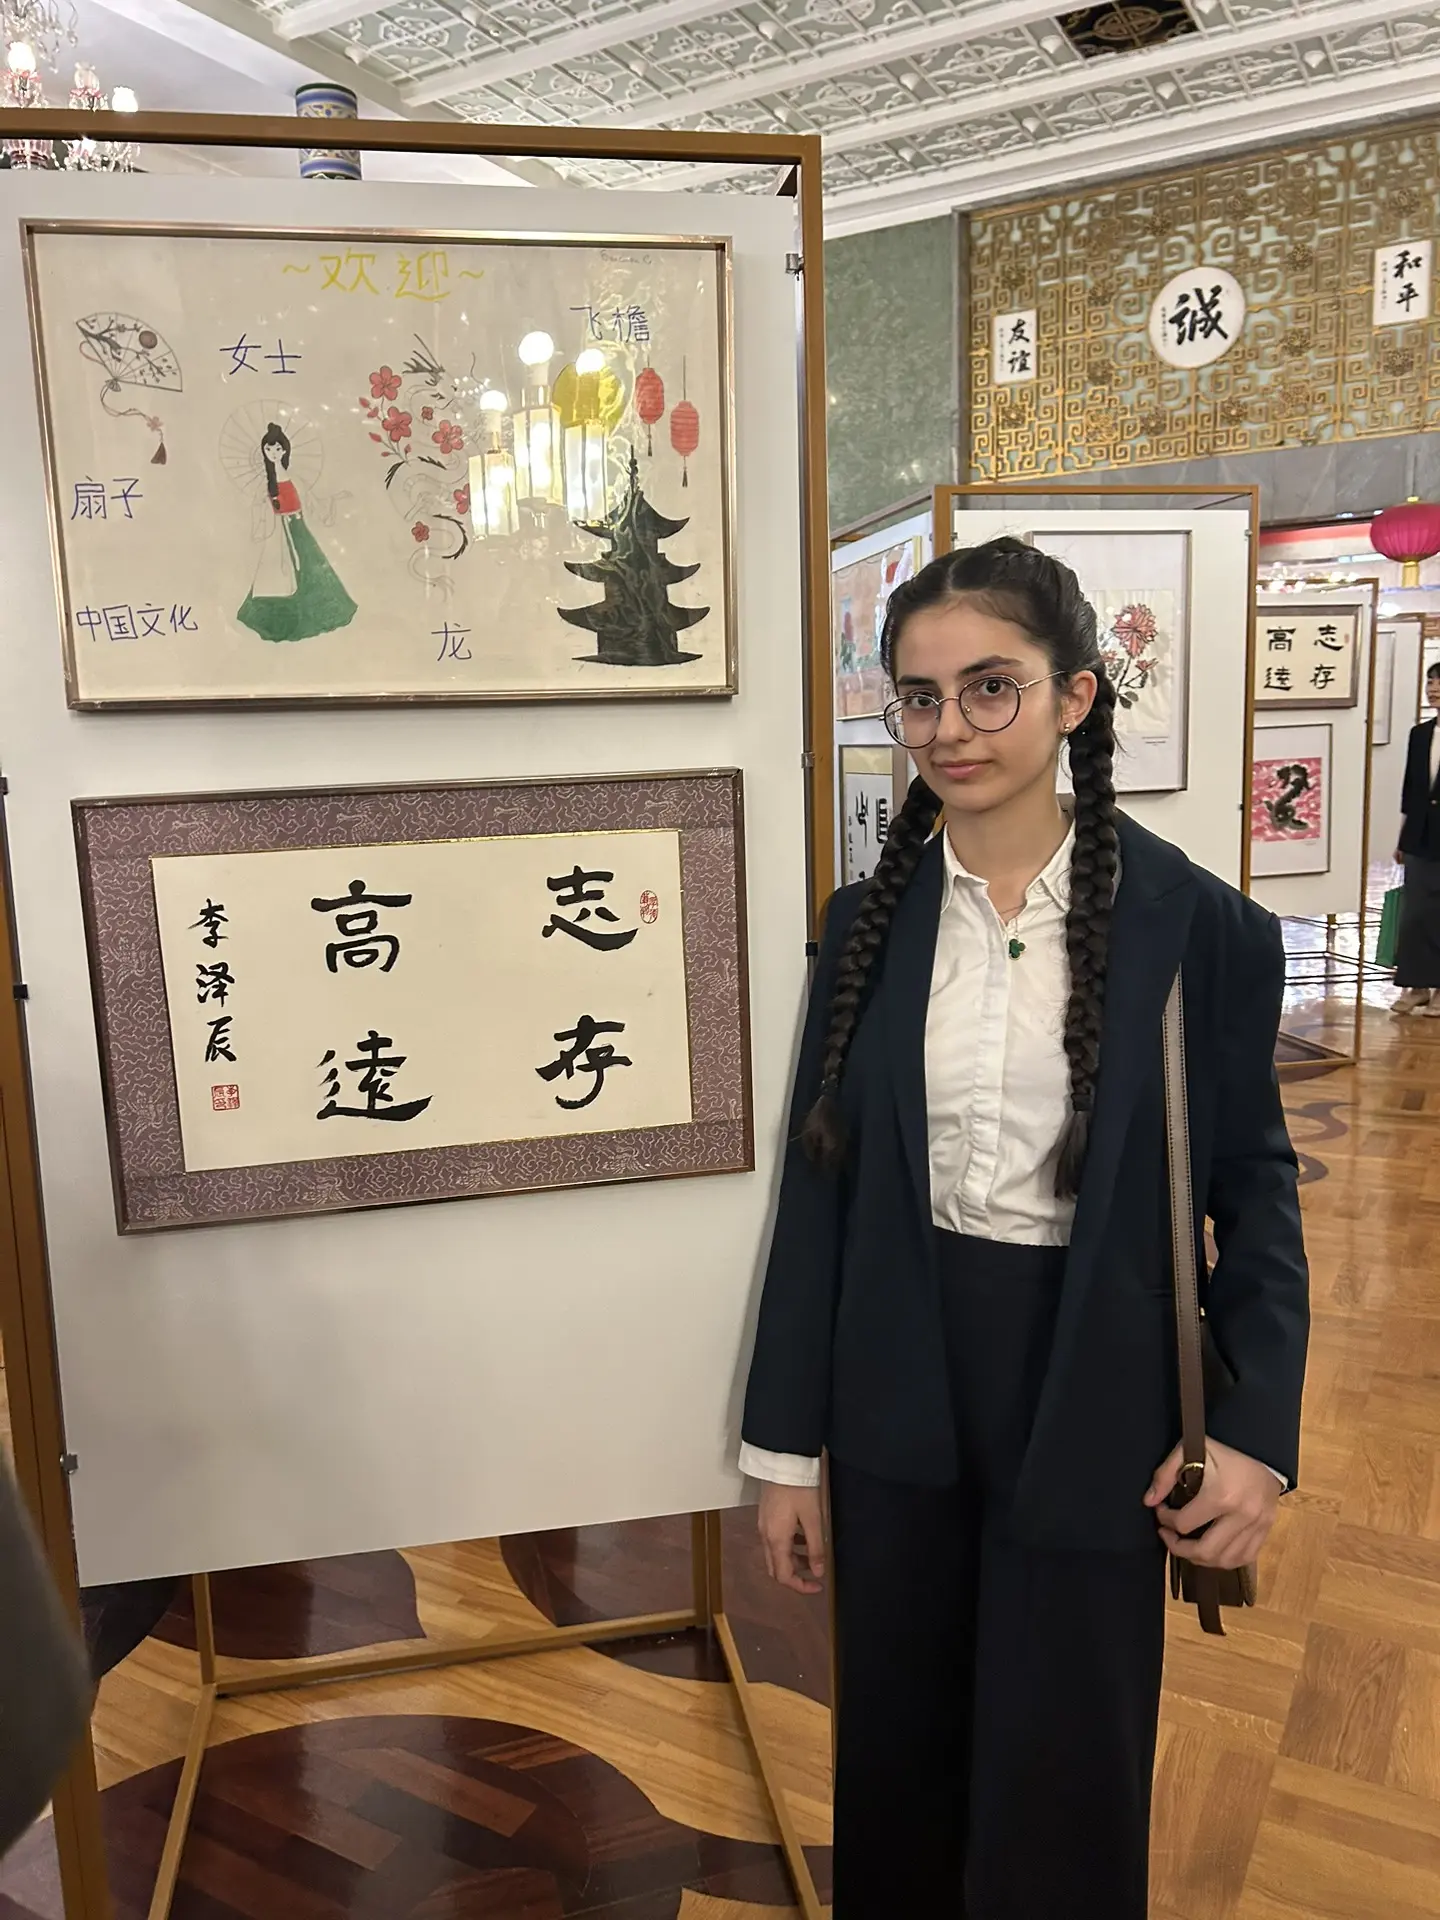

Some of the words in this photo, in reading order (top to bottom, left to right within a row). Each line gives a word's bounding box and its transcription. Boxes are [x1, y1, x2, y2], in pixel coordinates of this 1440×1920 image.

[1393, 250, 1423, 312] 和平
[220, 333, 302, 375] 女士
[71, 476, 143, 520] 扇子
[76, 603, 199, 642] 中国文化
[431, 621, 473, 662] 龙
